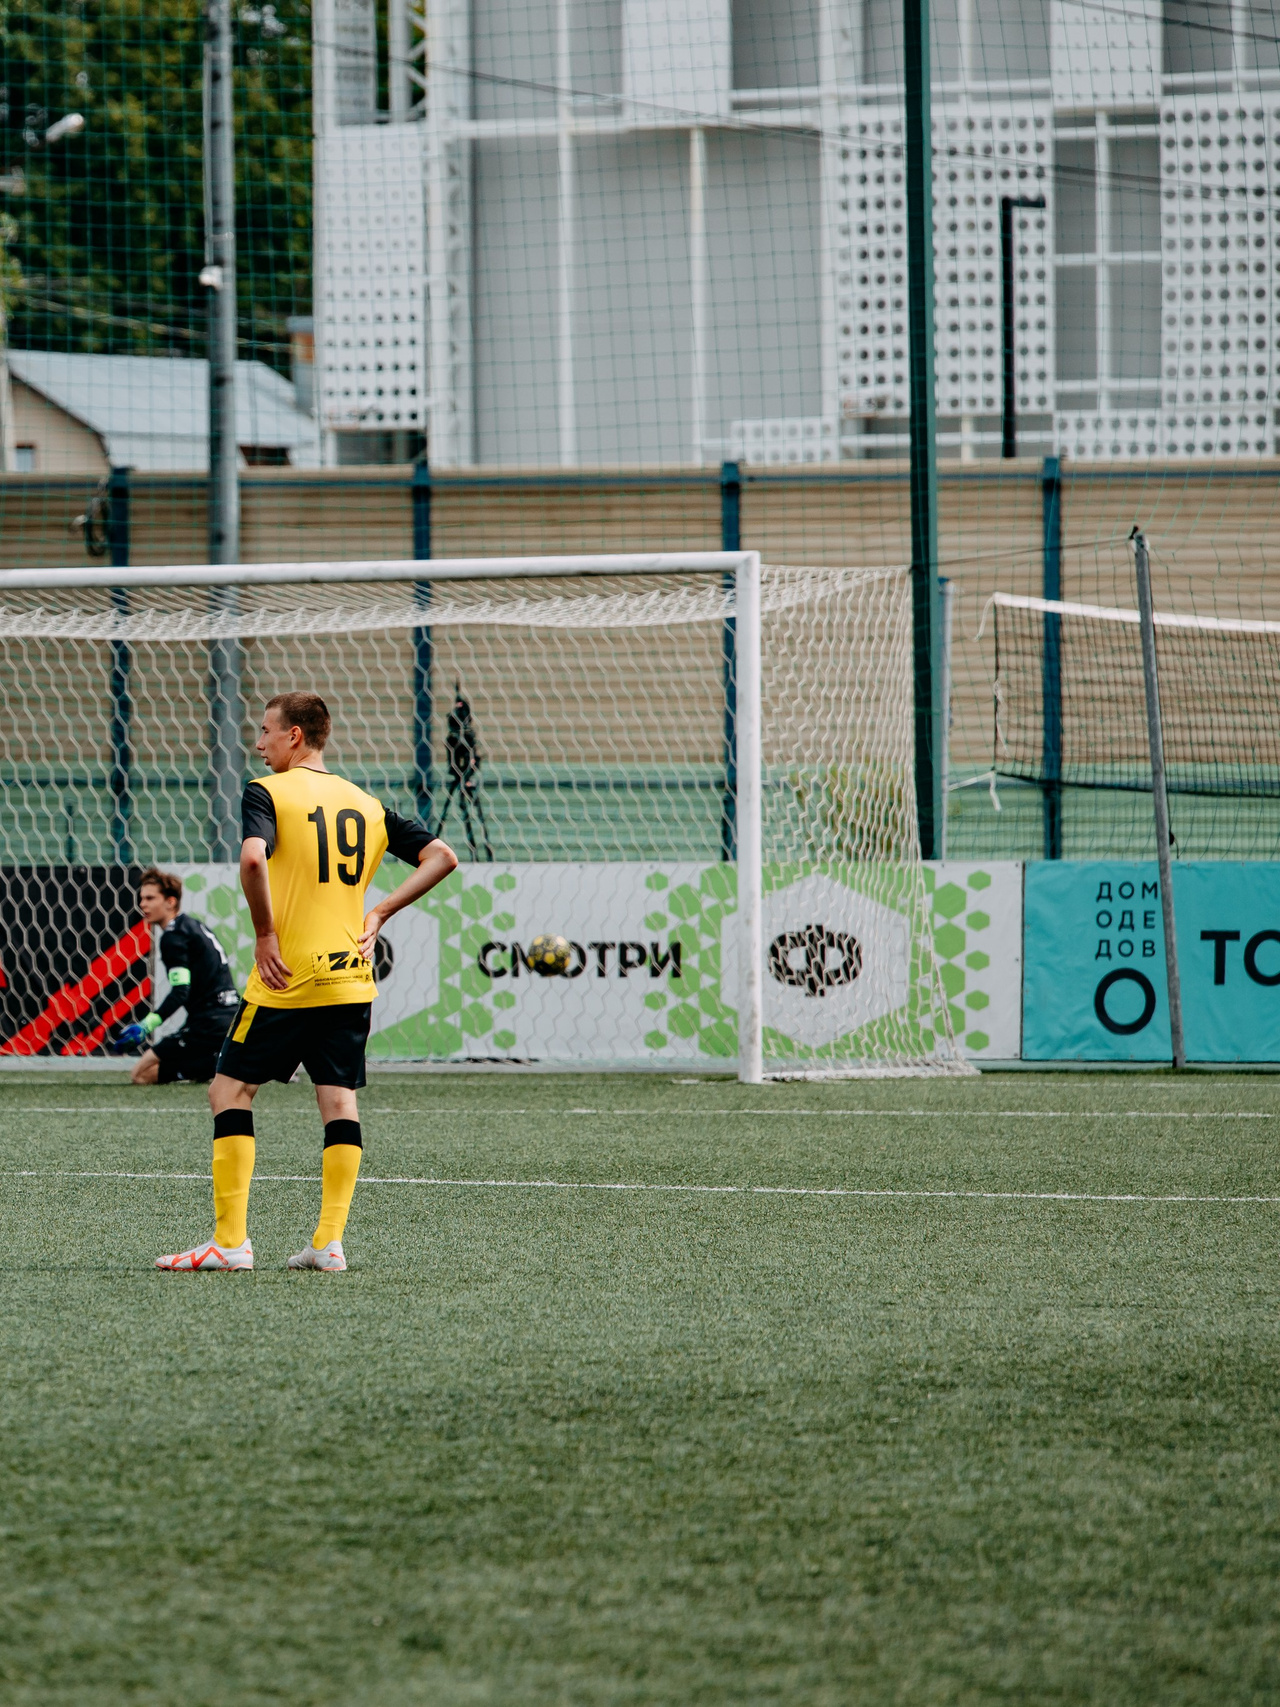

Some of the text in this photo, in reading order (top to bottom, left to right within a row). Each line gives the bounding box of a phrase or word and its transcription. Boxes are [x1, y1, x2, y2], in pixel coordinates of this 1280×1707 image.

[307, 805, 366, 886] 19
[1096, 881, 1158, 902] ДОМ
[1096, 910, 1156, 932] ОДЕ
[1095, 939, 1156, 961] ДОВ
